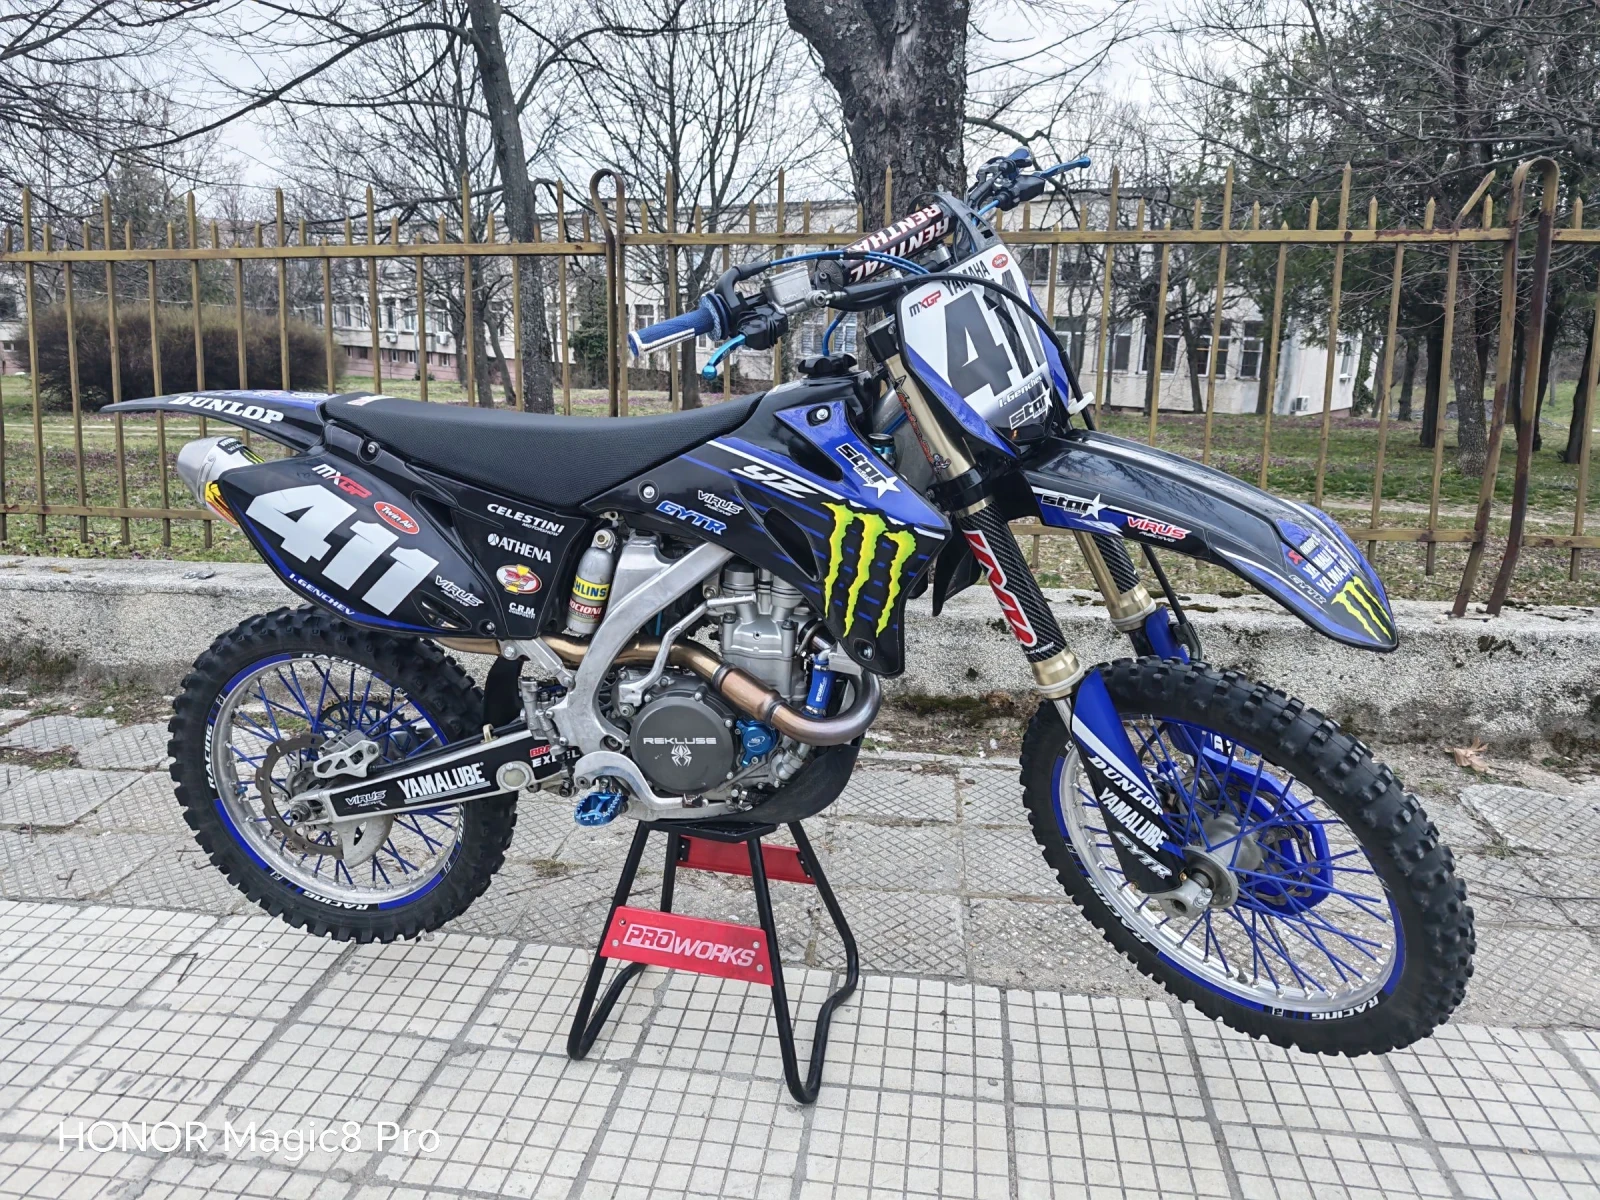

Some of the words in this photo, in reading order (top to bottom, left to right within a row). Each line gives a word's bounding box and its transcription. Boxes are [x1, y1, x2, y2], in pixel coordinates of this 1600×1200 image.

[847, 203, 941, 253] RENTHA
[909, 290, 941, 317] MXGP
[169, 395, 284, 424] DUNLOP
[836, 443, 888, 487] star
[312, 464, 372, 499] MXGP
[730, 464, 819, 499] YZ
[381, 505, 402, 522] Twin
[697, 489, 744, 514] VIRUS
[1041, 492, 1092, 513] star
[487, 503, 565, 533] CELESTINI
[656, 500, 728, 536] GYTR
[1126, 515, 1192, 540] VIRUS
[246, 484, 439, 616] 411
[498, 537, 551, 563] ATHENA
[289, 573, 356, 616] I.GENCHEV
[435, 574, 485, 607] VIRUS
[574, 580, 607, 598] HLINS
[204, 724, 216, 789] RACING
[643, 737, 717, 745] REKLUSE
[397, 763, 487, 800] YAMALUBE
[1087, 755, 1164, 816] DUNLOP
[345, 789, 387, 806] VIRUS
[1099, 787, 1168, 852] YAMALUBE
[1112, 831, 1173, 880] GYTR
[303, 890, 370, 911] RACING
[1311, 995, 1380, 1021] RACING
